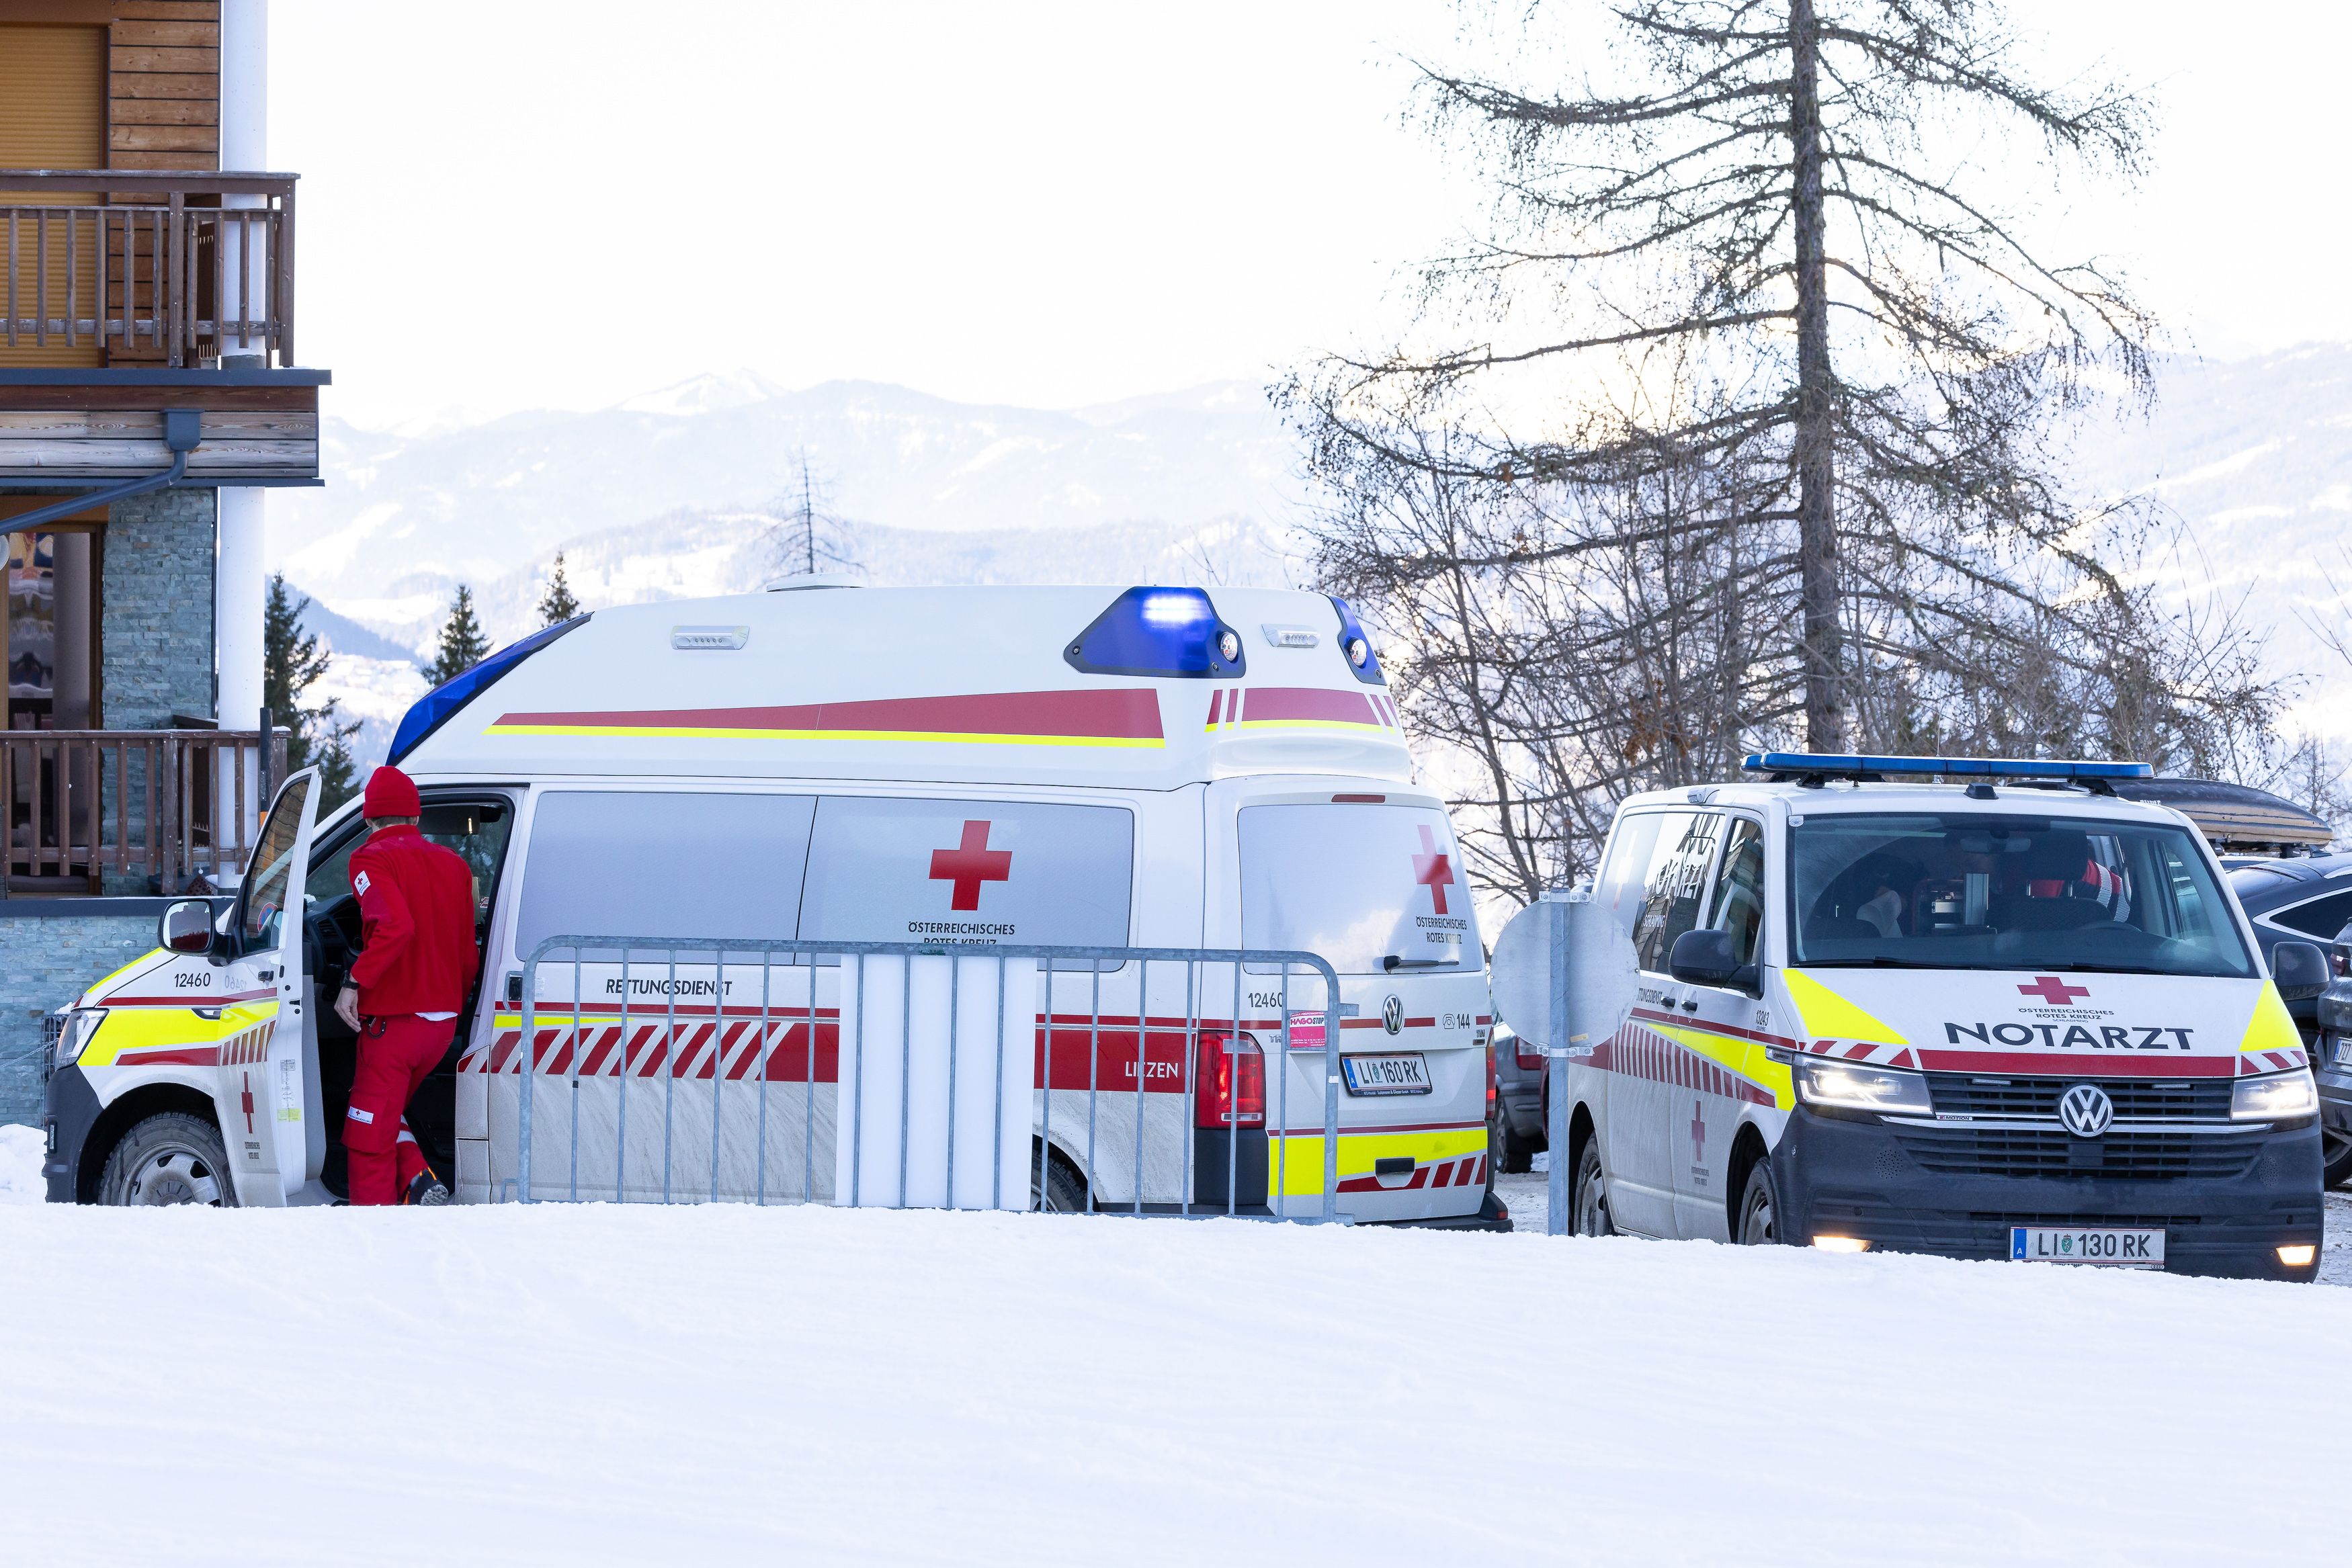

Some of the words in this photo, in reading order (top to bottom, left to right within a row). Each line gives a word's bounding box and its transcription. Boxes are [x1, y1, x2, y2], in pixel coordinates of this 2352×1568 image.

[908, 921, 1015, 934] ÖSTERREICHISCHES
[1416, 916, 1467, 930] ÖSTERREICHISCHES
[1427, 932, 1444, 943] ROTES
[1445, 933, 1462, 944] KREUZ
[174, 972, 211, 988] 12460
[606, 979, 732, 995] RETUNGSDIENT
[1248, 992, 1282, 1008] 12460
[1456, 1013, 1470, 1029] 144
[1755, 1010, 1769, 1027] 13243
[1944, 1022, 2194, 1050] NOTARZT
[1358, 1061, 1374, 1084] LI
[1380, 1061, 1404, 1083] 160
[1402, 1061, 1423, 1083] RK
[2060, 1085, 2113, 1137] VW
[2038, 1233, 2058, 1256] LI
[2078, 1233, 2116, 1256] 130
[2123, 1234, 2150, 1257] RK
